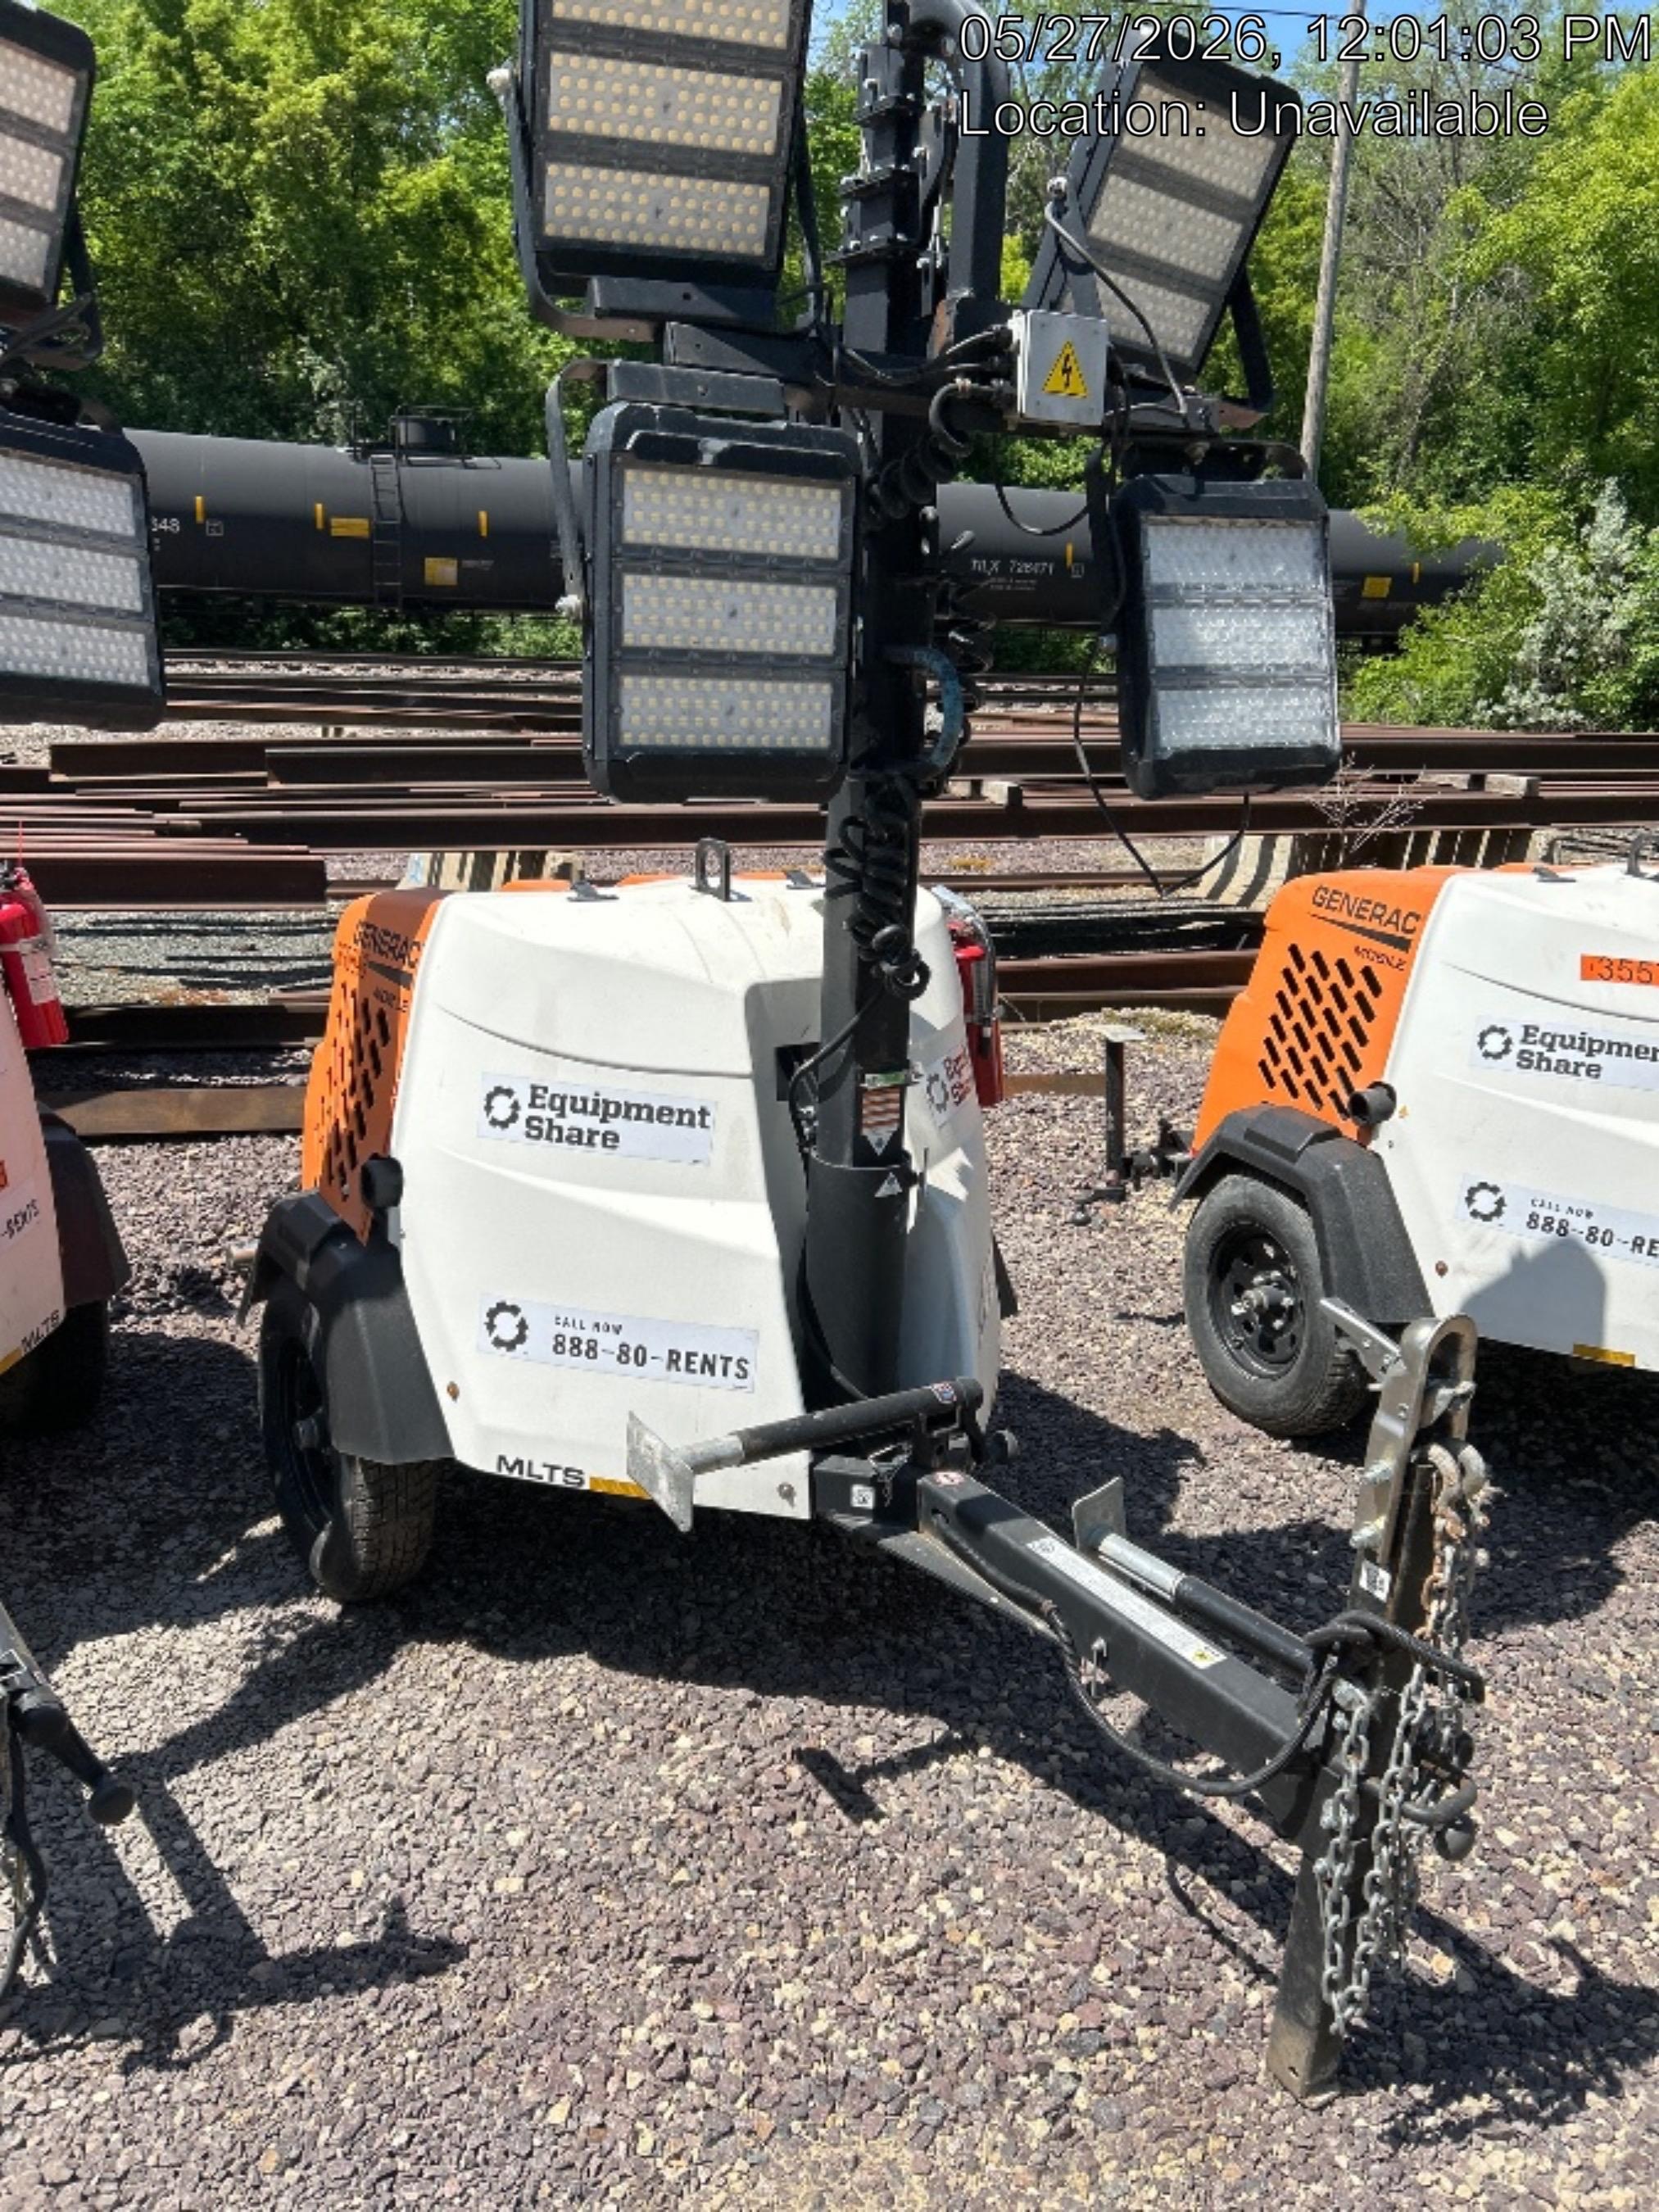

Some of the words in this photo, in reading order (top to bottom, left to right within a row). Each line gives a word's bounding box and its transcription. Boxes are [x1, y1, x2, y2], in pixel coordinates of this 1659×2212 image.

[1312, 885, 1421, 934] GENERAC
[1598, 955, 1659, 984] 355
[1516, 1049, 1602, 1080] Share
[528, 1084, 710, 1128] Equipment
[524, 1115, 620, 1149] Share
[555, 1316, 586, 1330] CALL
[592, 1321, 623, 1335] NOW
[552, 1333, 750, 1380] 888-80-RENTS
[497, 1455, 584, 1487] MLTS
